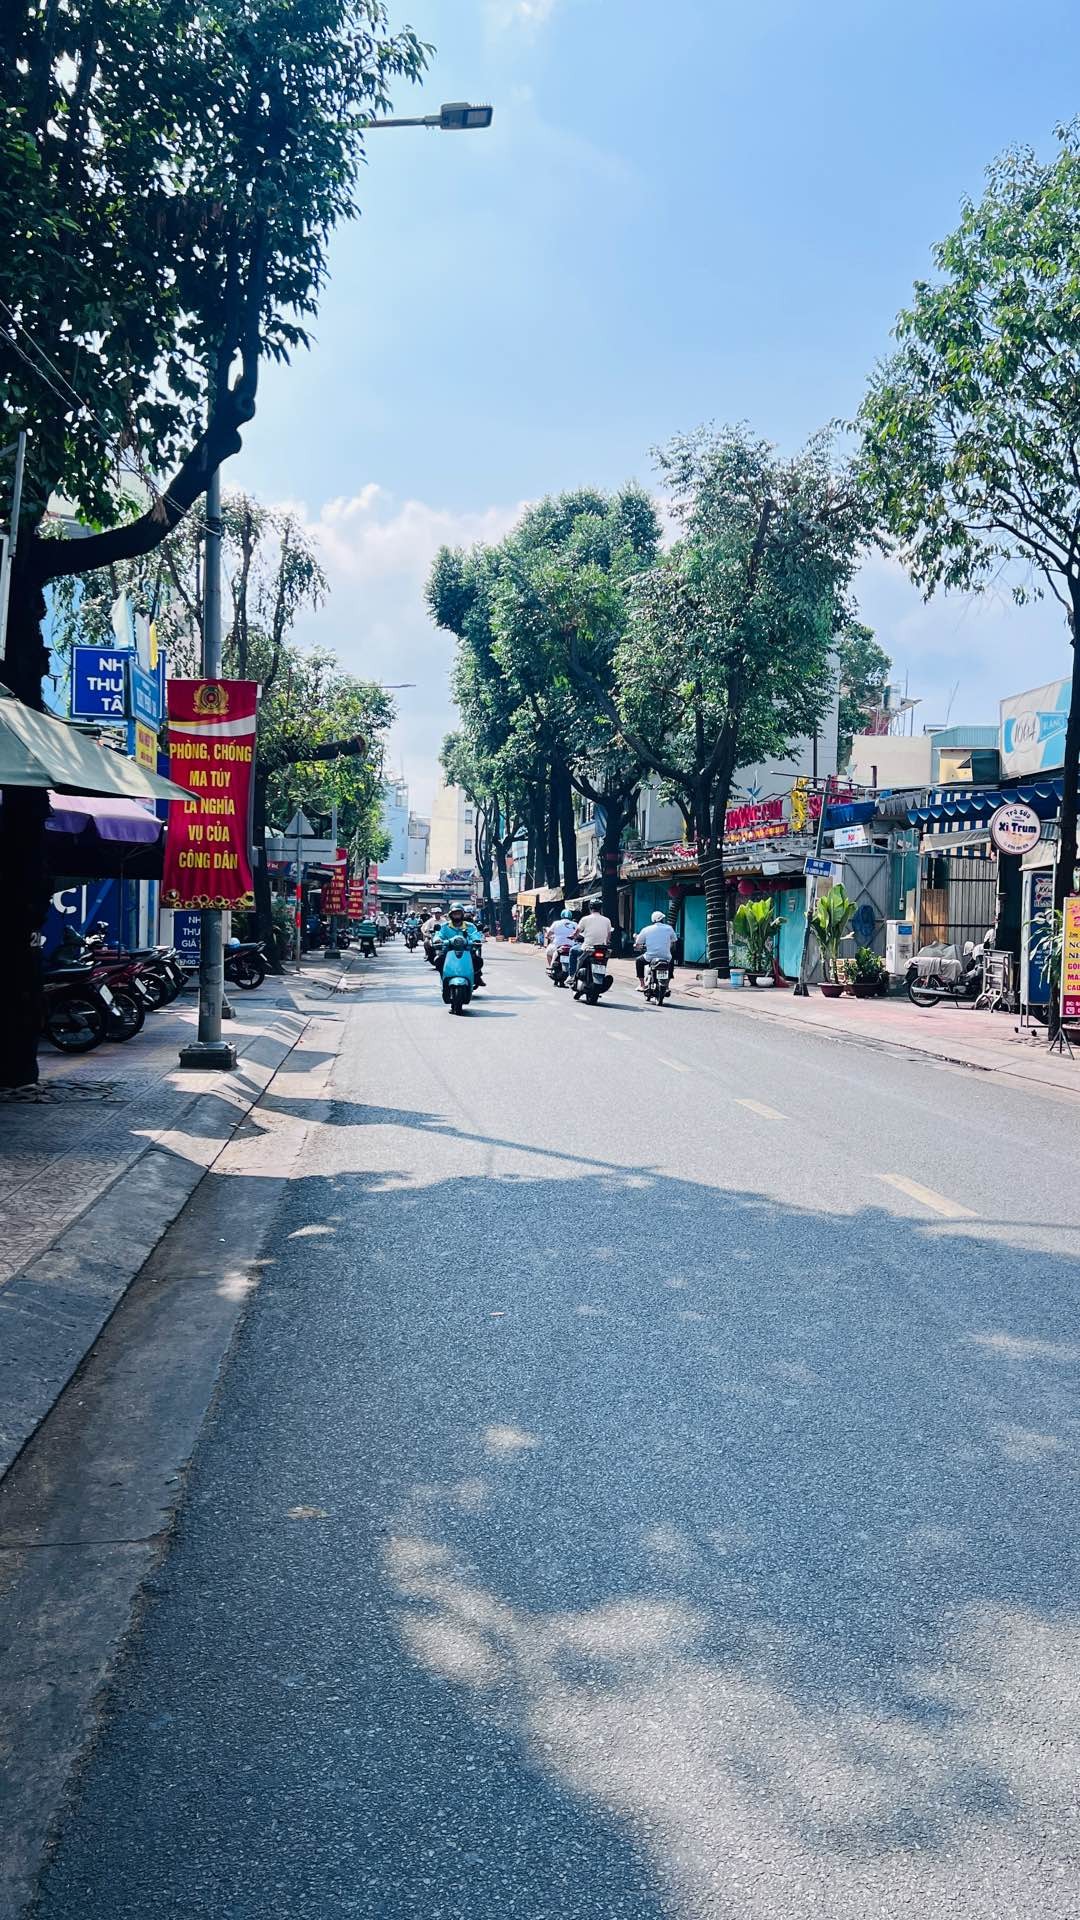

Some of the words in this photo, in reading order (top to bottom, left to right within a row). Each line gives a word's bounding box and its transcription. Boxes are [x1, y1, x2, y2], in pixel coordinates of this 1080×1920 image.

[99, 657, 124, 672] NH
[86, 676, 124, 692] THU
[101, 695, 125, 712] TÂ
[169, 739, 210, 761] PHÒNG,
[213, 739, 252, 762] CHỐNG
[189, 770, 208, 787] MA
[210, 767, 231, 788] TÚY
[200, 796, 235, 815] NGHĨA
[188, 824, 203, 844] VỤ
[206, 820, 230, 842] CỦA
[1011, 822, 1037, 834] Trum
[178, 848, 211, 869] CÔNG
[213, 849, 238, 870] DÂN
[188, 916, 201, 924] NH
[182, 927, 201, 936] THU
